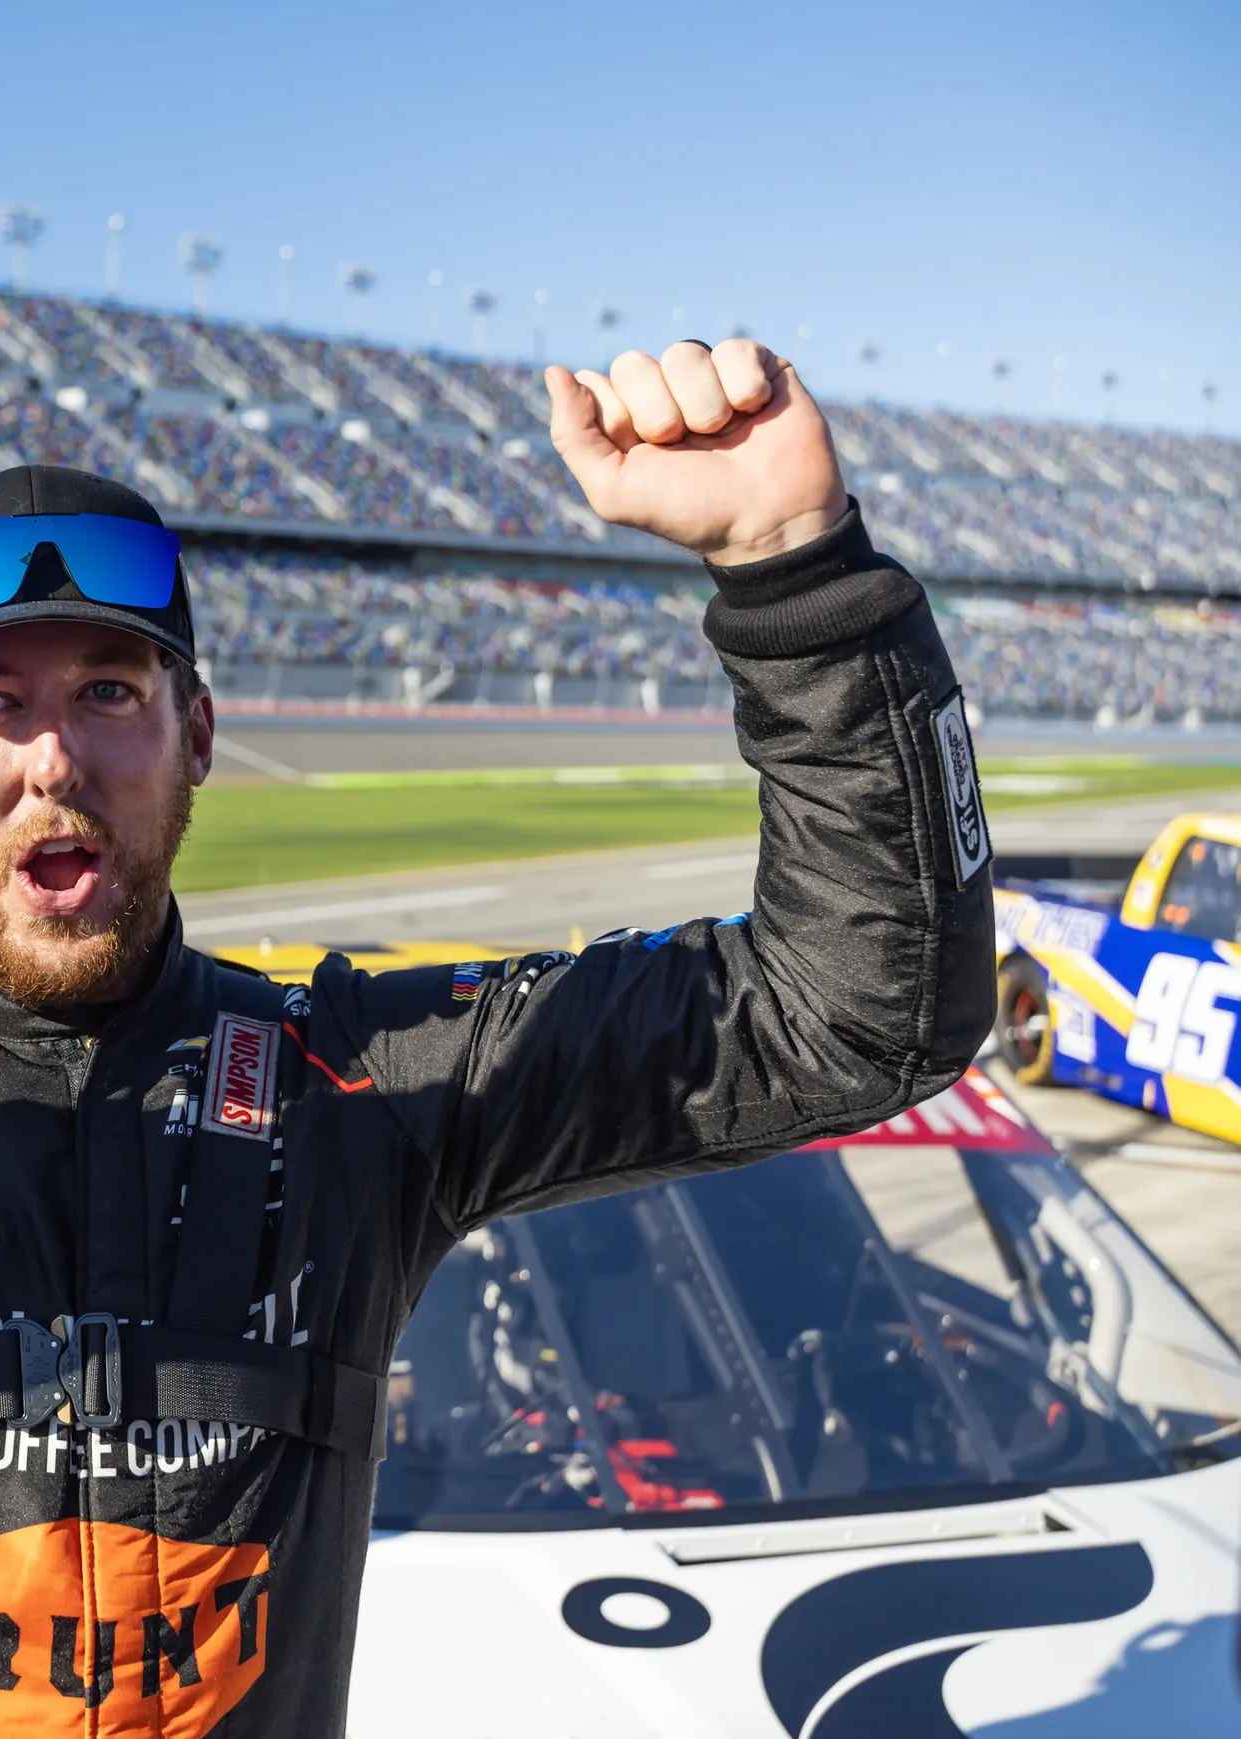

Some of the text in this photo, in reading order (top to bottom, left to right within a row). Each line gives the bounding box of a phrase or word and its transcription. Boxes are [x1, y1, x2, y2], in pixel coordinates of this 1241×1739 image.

[1126, 952, 1241, 1087] 95
[222, 1027, 262, 1126] SIMPSON
[126, 1418, 278, 1477] COMP
